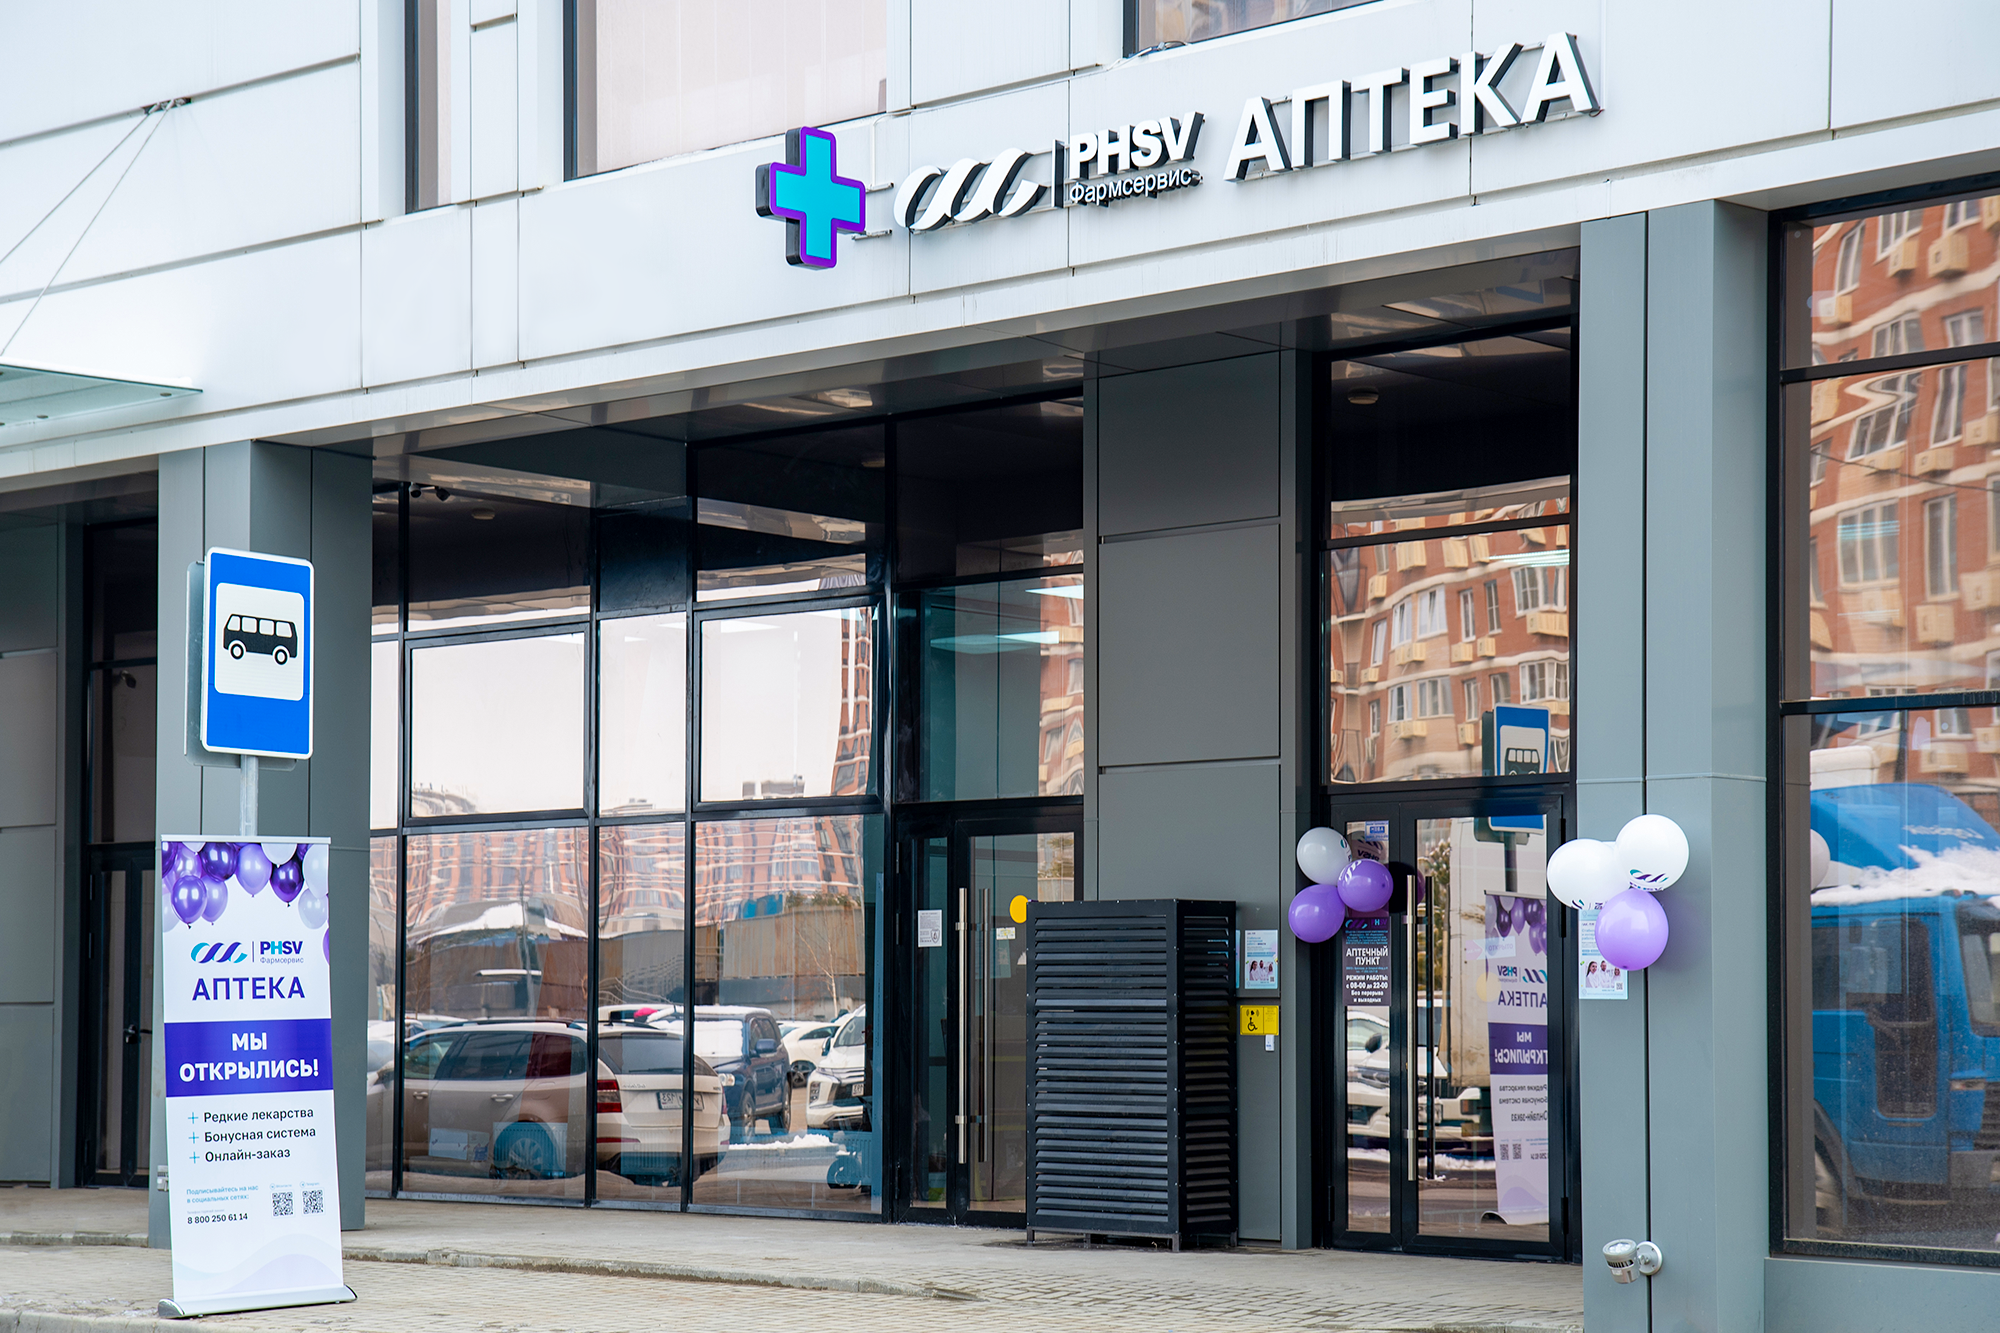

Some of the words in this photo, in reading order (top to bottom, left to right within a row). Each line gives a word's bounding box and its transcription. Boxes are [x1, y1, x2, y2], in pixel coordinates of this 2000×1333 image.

[1224, 32, 1598, 182] АПТЕКА
[1069, 111, 1201, 180] PHSV
[1069, 168, 1197, 206] Фармсервис
[260, 940, 304, 955] PHSV
[1345, 945, 1388, 957] АПТЕЧНЫЙ
[260, 956, 304, 965] Фармсервис
[1355, 956, 1380, 966] ПУНКТ
[191, 976, 306, 1001] АПТЕКА
[1372, 981, 1388, 989] 22-00
[231, 1032, 268, 1051] МЫ
[179, 1058, 319, 1082] ОТКРЫЛИСЬ!
[203, 1111, 249, 1124] Редкие
[251, 1108, 314, 1122] лекарства
[204, 1131, 264, 1145] Бонусная
[266, 1128, 316, 1139] система
[205, 1148, 291, 1162] Онлайн-заказ
[186, 1186, 239, 1196] Подписывайтесь
[191, 1195, 229, 1203] социальных
[187, 1216, 193, 1225] 8
[194, 1215, 210, 1224] 800
[211, 1214, 227, 1223] 250
[228, 1213, 238, 1222] 61
[239, 1212, 248, 1221] 14
